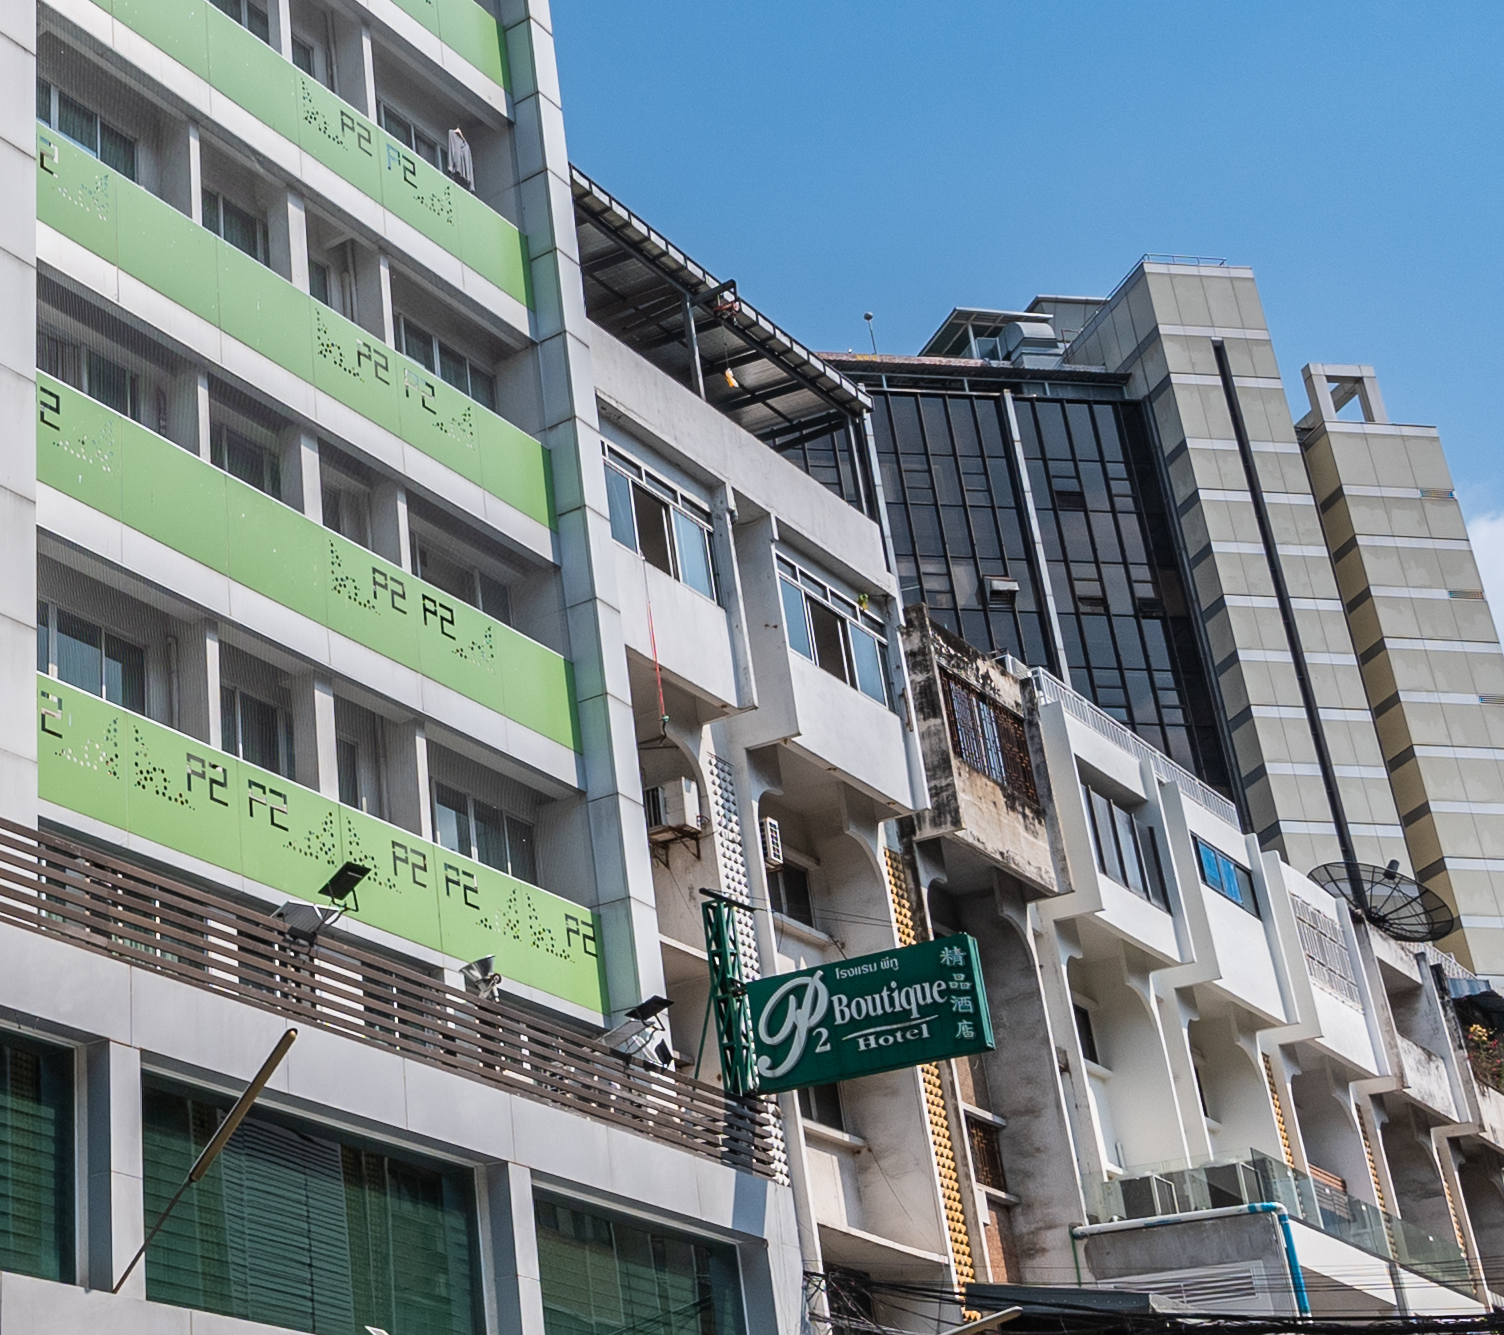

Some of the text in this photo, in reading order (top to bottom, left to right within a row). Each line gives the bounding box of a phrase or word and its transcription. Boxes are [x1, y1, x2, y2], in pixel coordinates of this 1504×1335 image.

[835, 962, 877, 980] โรงแรม
[831, 979, 948, 1026] Boutique
[940, 946, 977, 1041] 精品酒店
[857, 1023, 931, 1052] Hotel
